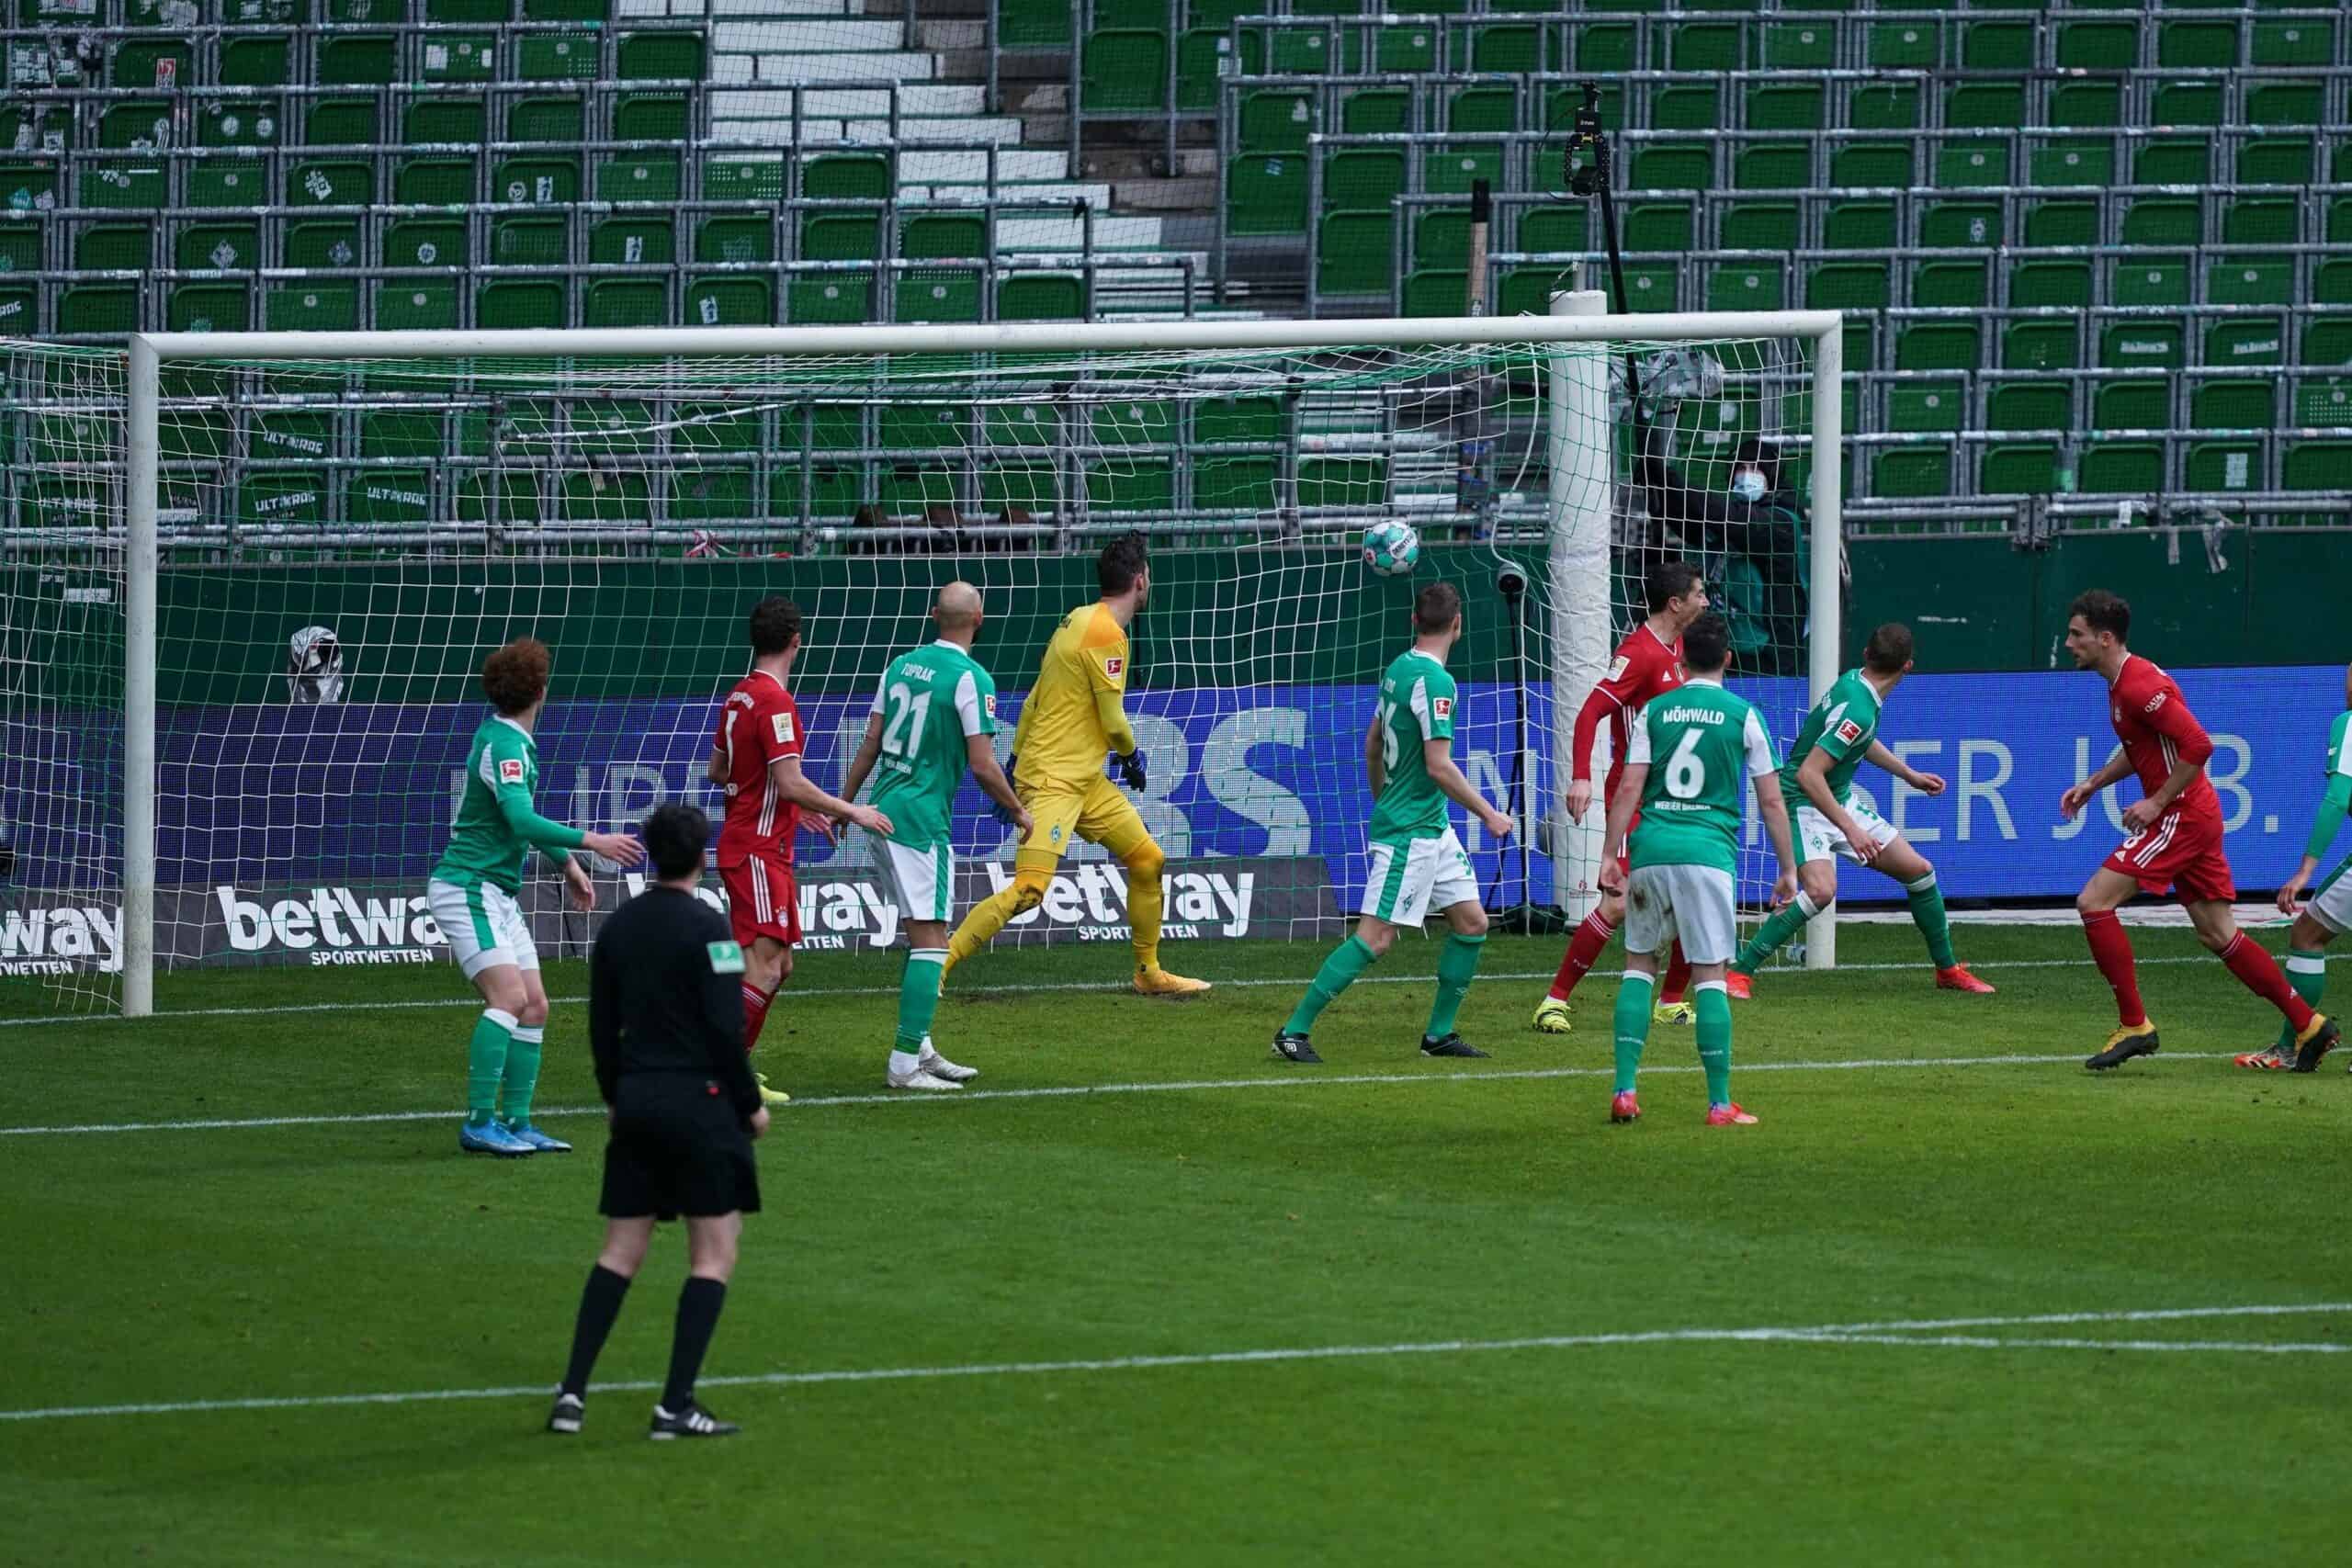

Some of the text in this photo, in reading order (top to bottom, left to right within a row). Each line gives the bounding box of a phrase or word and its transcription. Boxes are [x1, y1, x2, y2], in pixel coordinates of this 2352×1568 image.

[900, 662, 935, 682] TOPRAK
[881, 682, 933, 761] 21
[1663, 705, 1724, 725] MÖHWALD
[1665, 727, 1705, 799] 6
[217, 886, 449, 951] betwa
[311, 949, 435, 965] SPORTWETTEN
